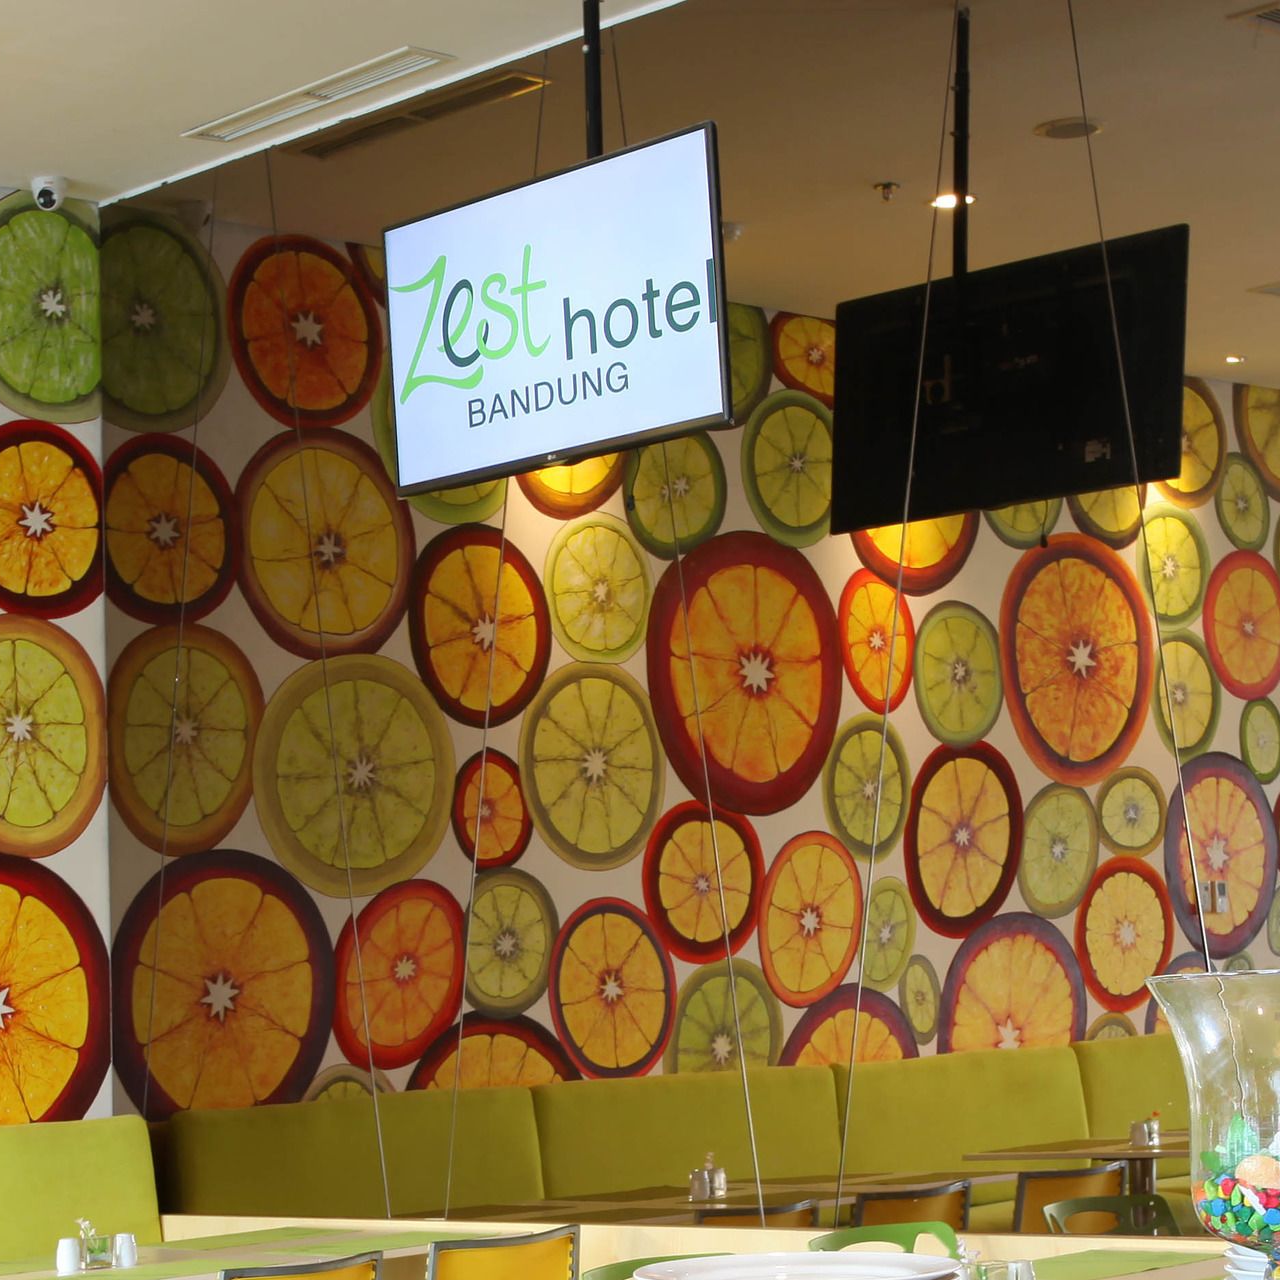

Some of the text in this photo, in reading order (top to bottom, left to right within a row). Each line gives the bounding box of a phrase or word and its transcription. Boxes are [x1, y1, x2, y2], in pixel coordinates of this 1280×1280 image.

[389, 243, 718, 405] Zest hotel
[468, 361, 629, 428] BANDUNG
